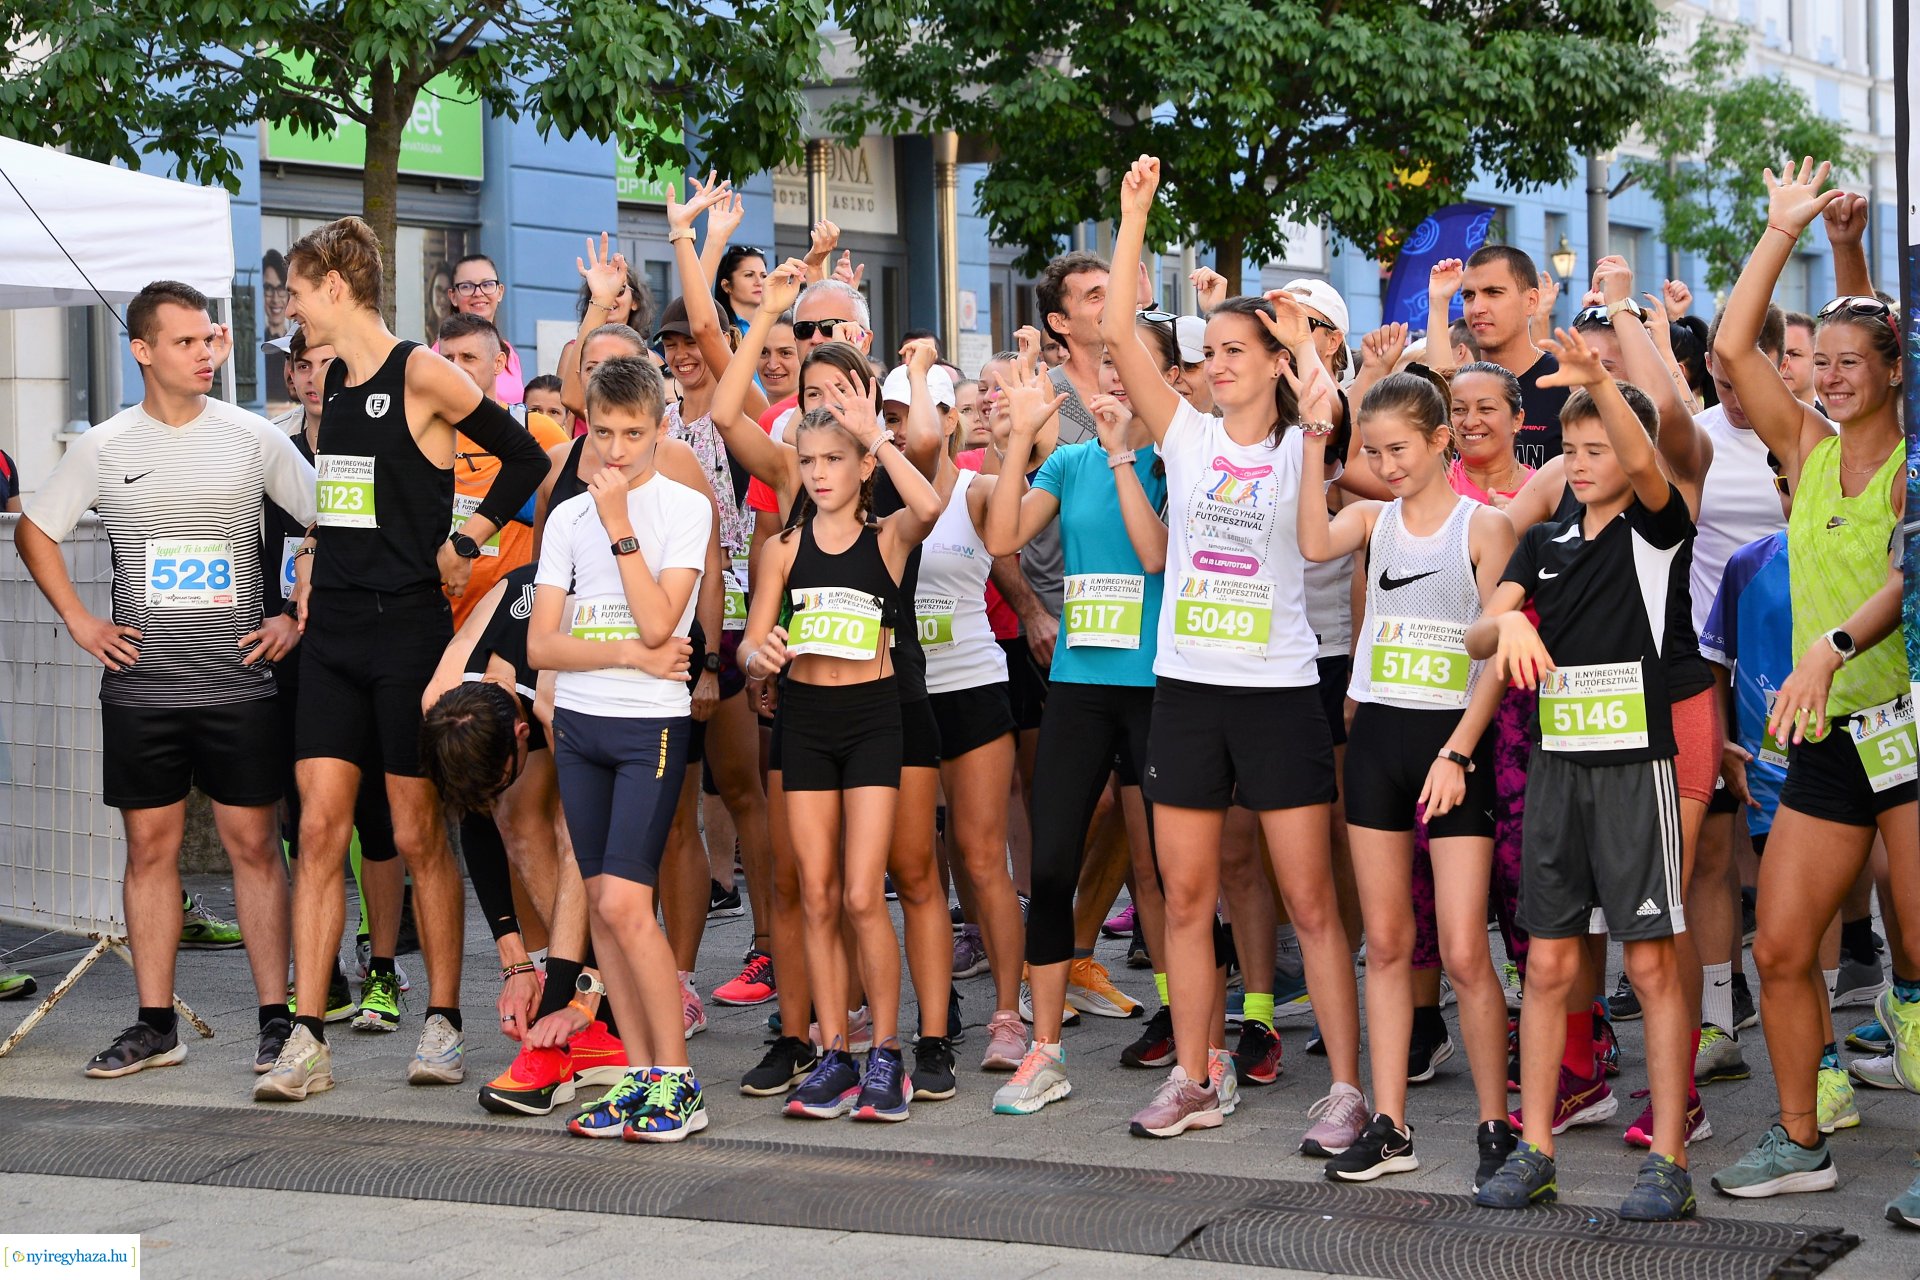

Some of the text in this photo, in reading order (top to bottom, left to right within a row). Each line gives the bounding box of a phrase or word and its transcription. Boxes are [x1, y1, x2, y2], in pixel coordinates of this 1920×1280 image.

[320, 485, 363, 510] 5123
[1195, 511, 1263, 531] FUTÓFESZTIVÁL
[1206, 503, 1265, 521] NYÍREGYHÁZI
[151, 559, 231, 590] 528
[1212, 586, 1270, 600] FUTÓFESZTIVÁL
[800, 615, 865, 644] 5070
[1070, 604, 1125, 630] 5117
[1186, 606, 1254, 638] 5049
[1382, 651, 1452, 685] 5143
[1575, 676, 1639, 688] FUTÓFESZTIVÁL
[1553, 700, 1628, 732] 5146
[1877, 730, 1917, 766] 51
